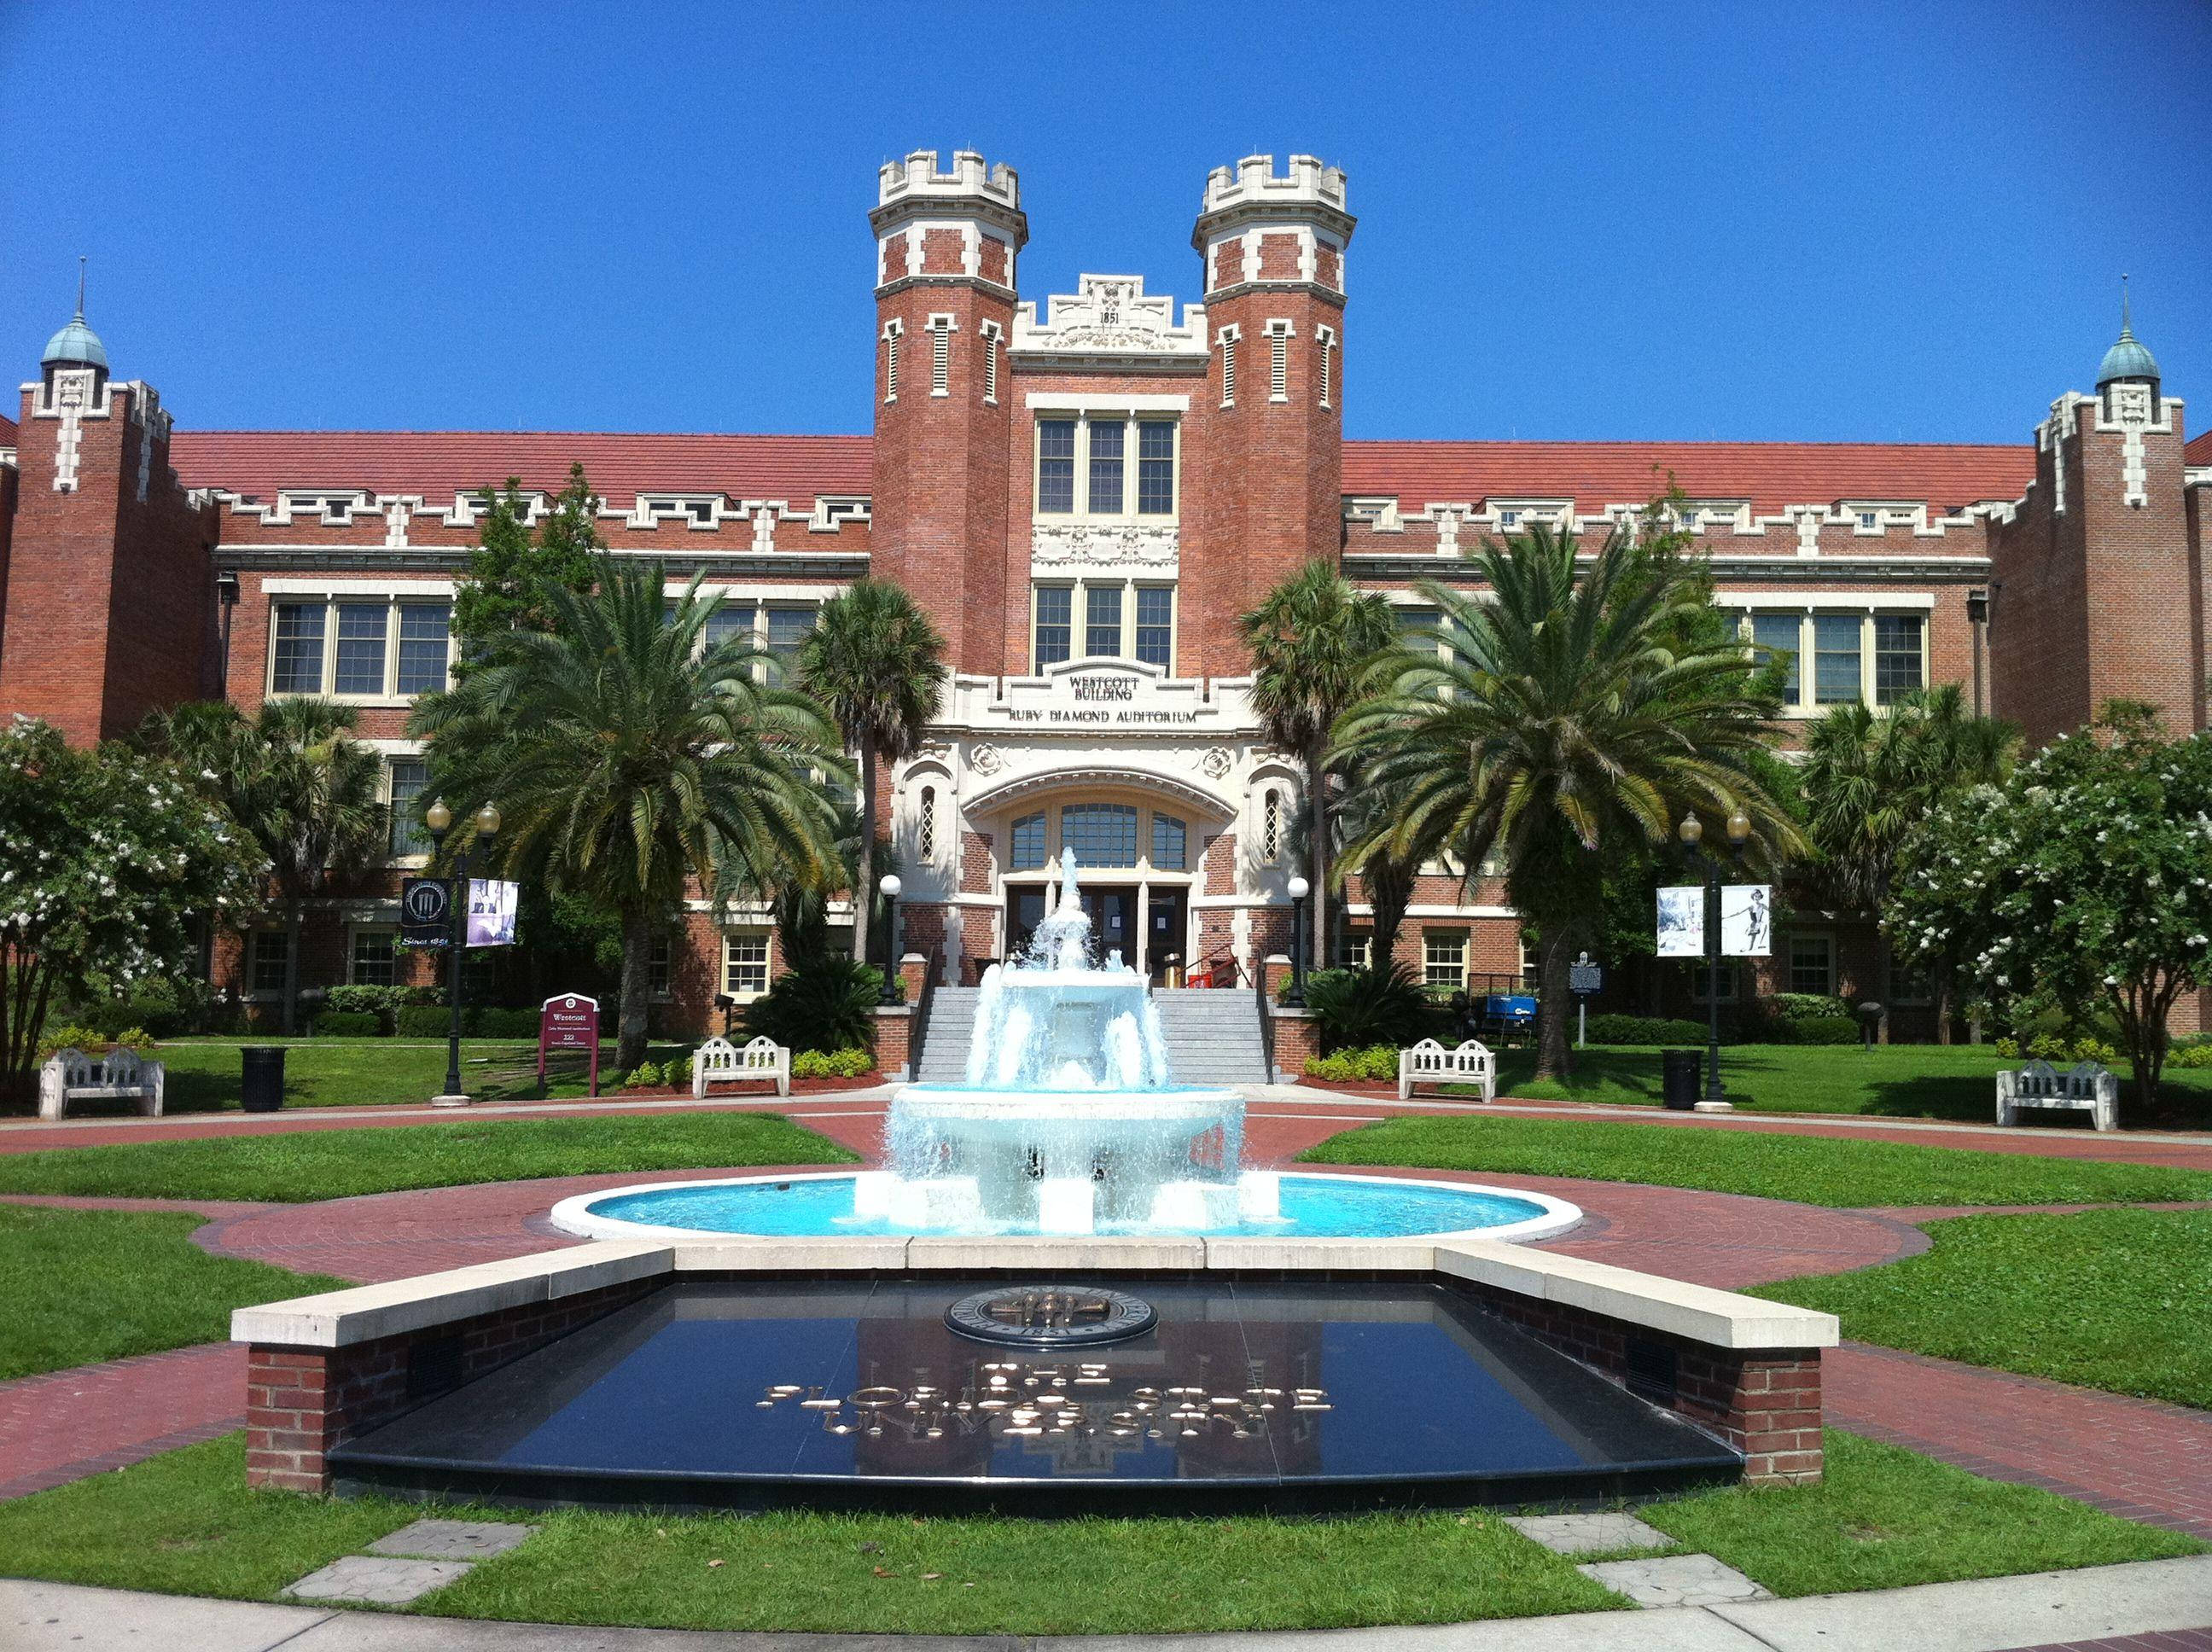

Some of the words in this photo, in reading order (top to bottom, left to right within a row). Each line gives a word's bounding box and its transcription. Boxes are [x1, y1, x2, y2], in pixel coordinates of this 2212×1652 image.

[1100, 312, 1119, 323] 1851
[1069, 677, 1139, 689] WESTCOTT
[1075, 689, 1132, 701] BUILDING
[1010, 710, 1043, 721] RUBY
[1050, 710, 1109, 722] DIAMOND
[1116, 711, 1196, 724] AUDITORIUM
[981, 1364, 1111, 1387] THE
[756, 1384, 1080, 1411] FLORIDA
[1128, 1386, 1336, 1411] STATE
[823, 1410, 1265, 1438] UNIVERSITY
